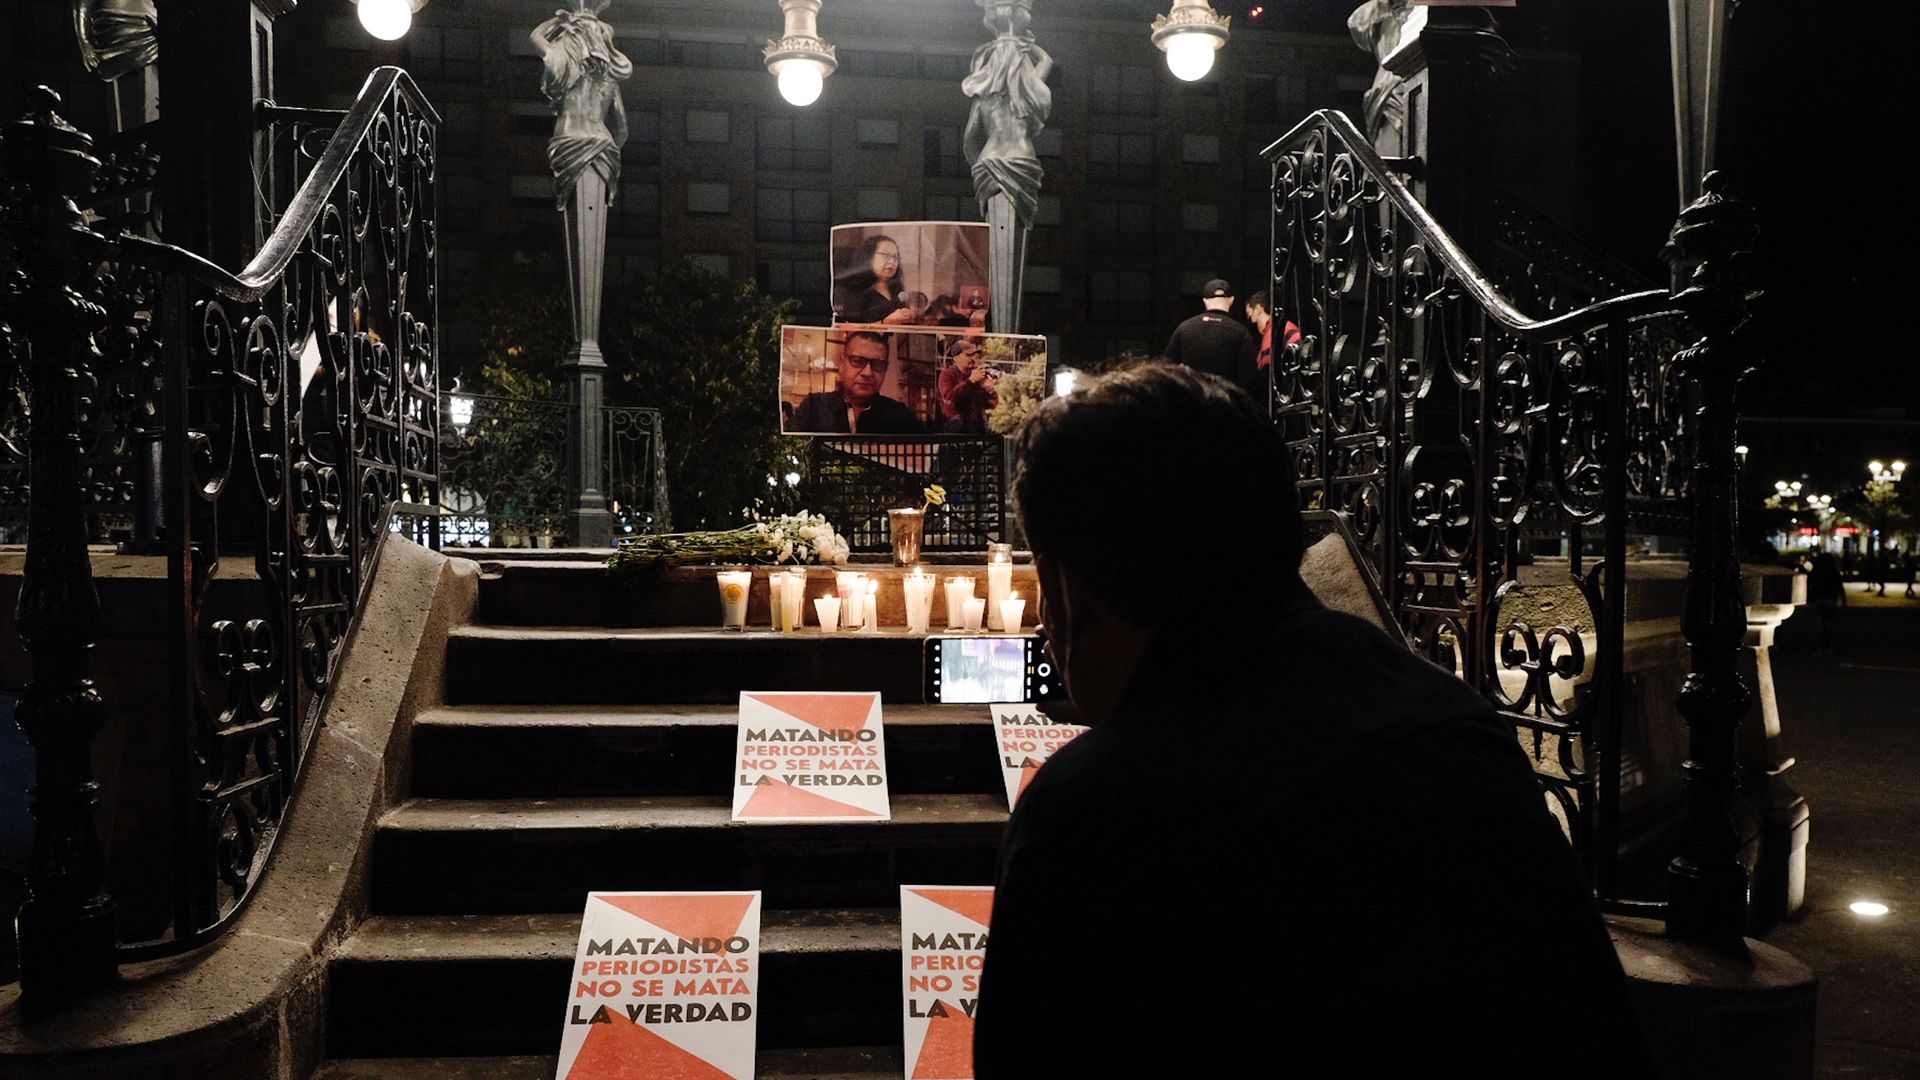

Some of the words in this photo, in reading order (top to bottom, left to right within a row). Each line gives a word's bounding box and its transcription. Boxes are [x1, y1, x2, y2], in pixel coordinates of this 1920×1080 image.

[745, 728, 877, 742] MATANDO
[743, 745, 879, 757] PERIODISTAS
[1002, 741, 1037, 752] NO
[741, 759, 778, 771] NO
[785, 759, 811, 770] SE
[818, 759, 881, 771] MATA
[1005, 756, 1039, 769] LA
[740, 774, 774, 787] LA
[782, 775, 883, 787] VERDAD
[586, 936, 750, 956] MATANDO
[581, 958, 750, 976] PERIODISTAS
[575, 980, 622, 998] NO
[631, 980, 663, 997] SE
[673, 977, 751, 996] MATA
[910, 974, 952, 992] NO
[962, 974, 982, 992] S
[570, 1004, 612, 1025] LA
[626, 1001, 752, 1024] VERDAD
[909, 998, 950, 1018] LA
